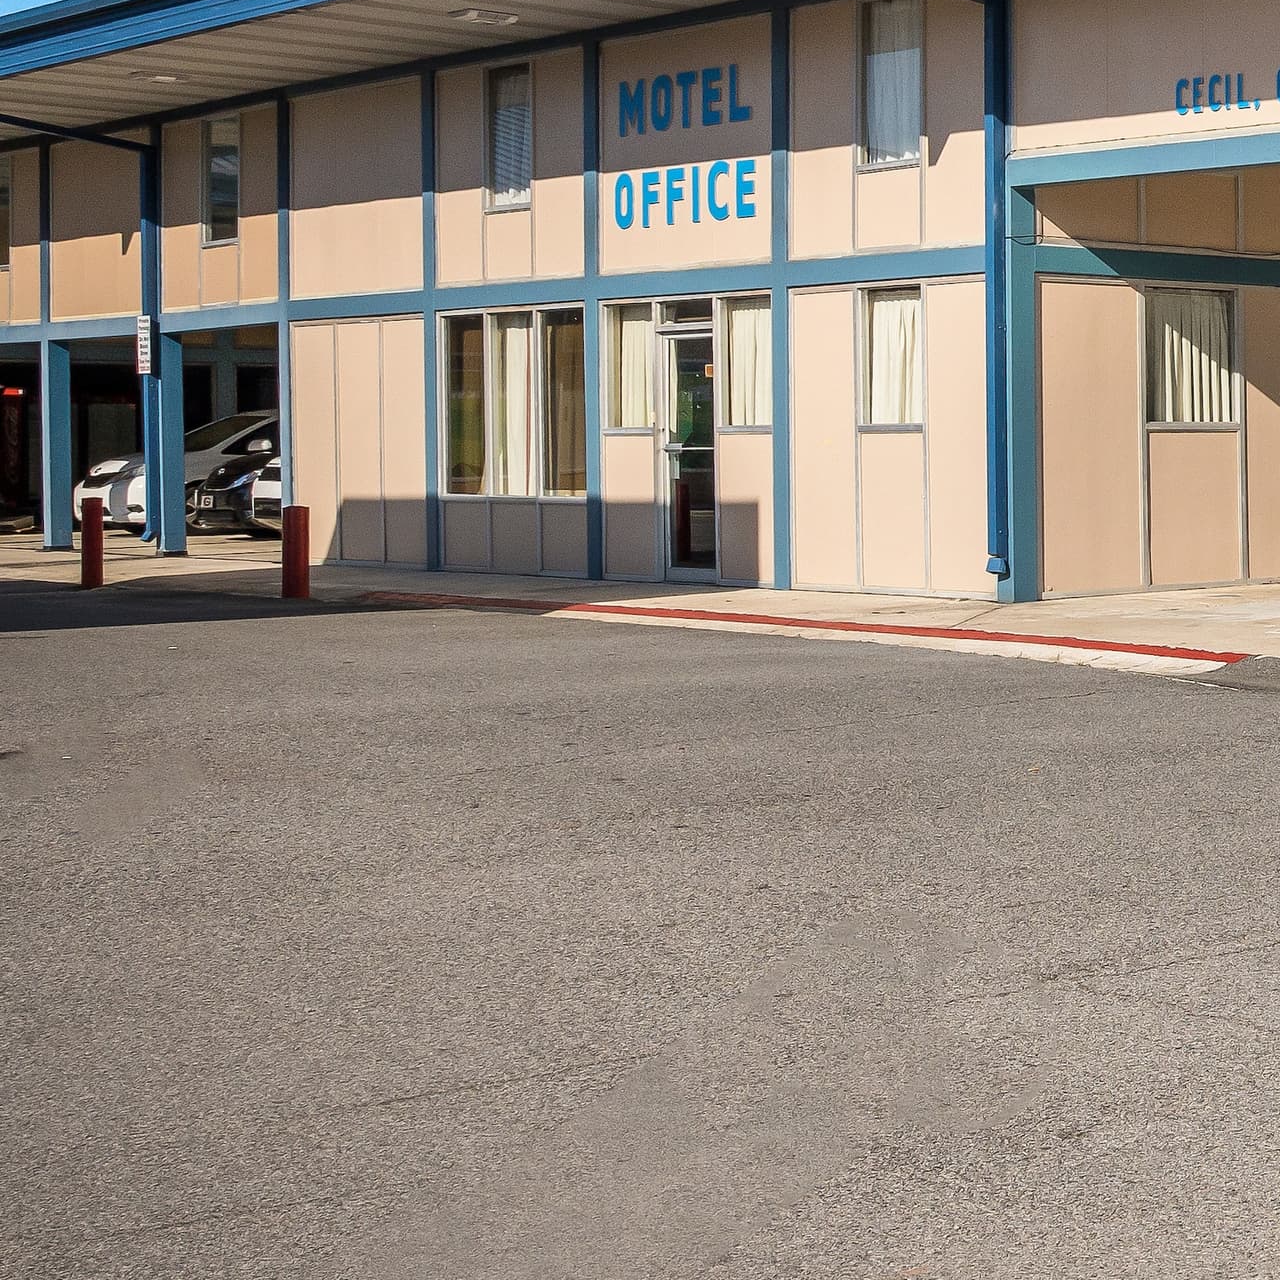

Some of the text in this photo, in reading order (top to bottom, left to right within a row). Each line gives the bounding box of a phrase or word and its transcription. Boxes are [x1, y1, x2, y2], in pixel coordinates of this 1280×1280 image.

[619, 64, 752, 137] MOTEL
[1175, 72, 1261, 115] CECIL,
[615, 159, 757, 230] OFFICE
